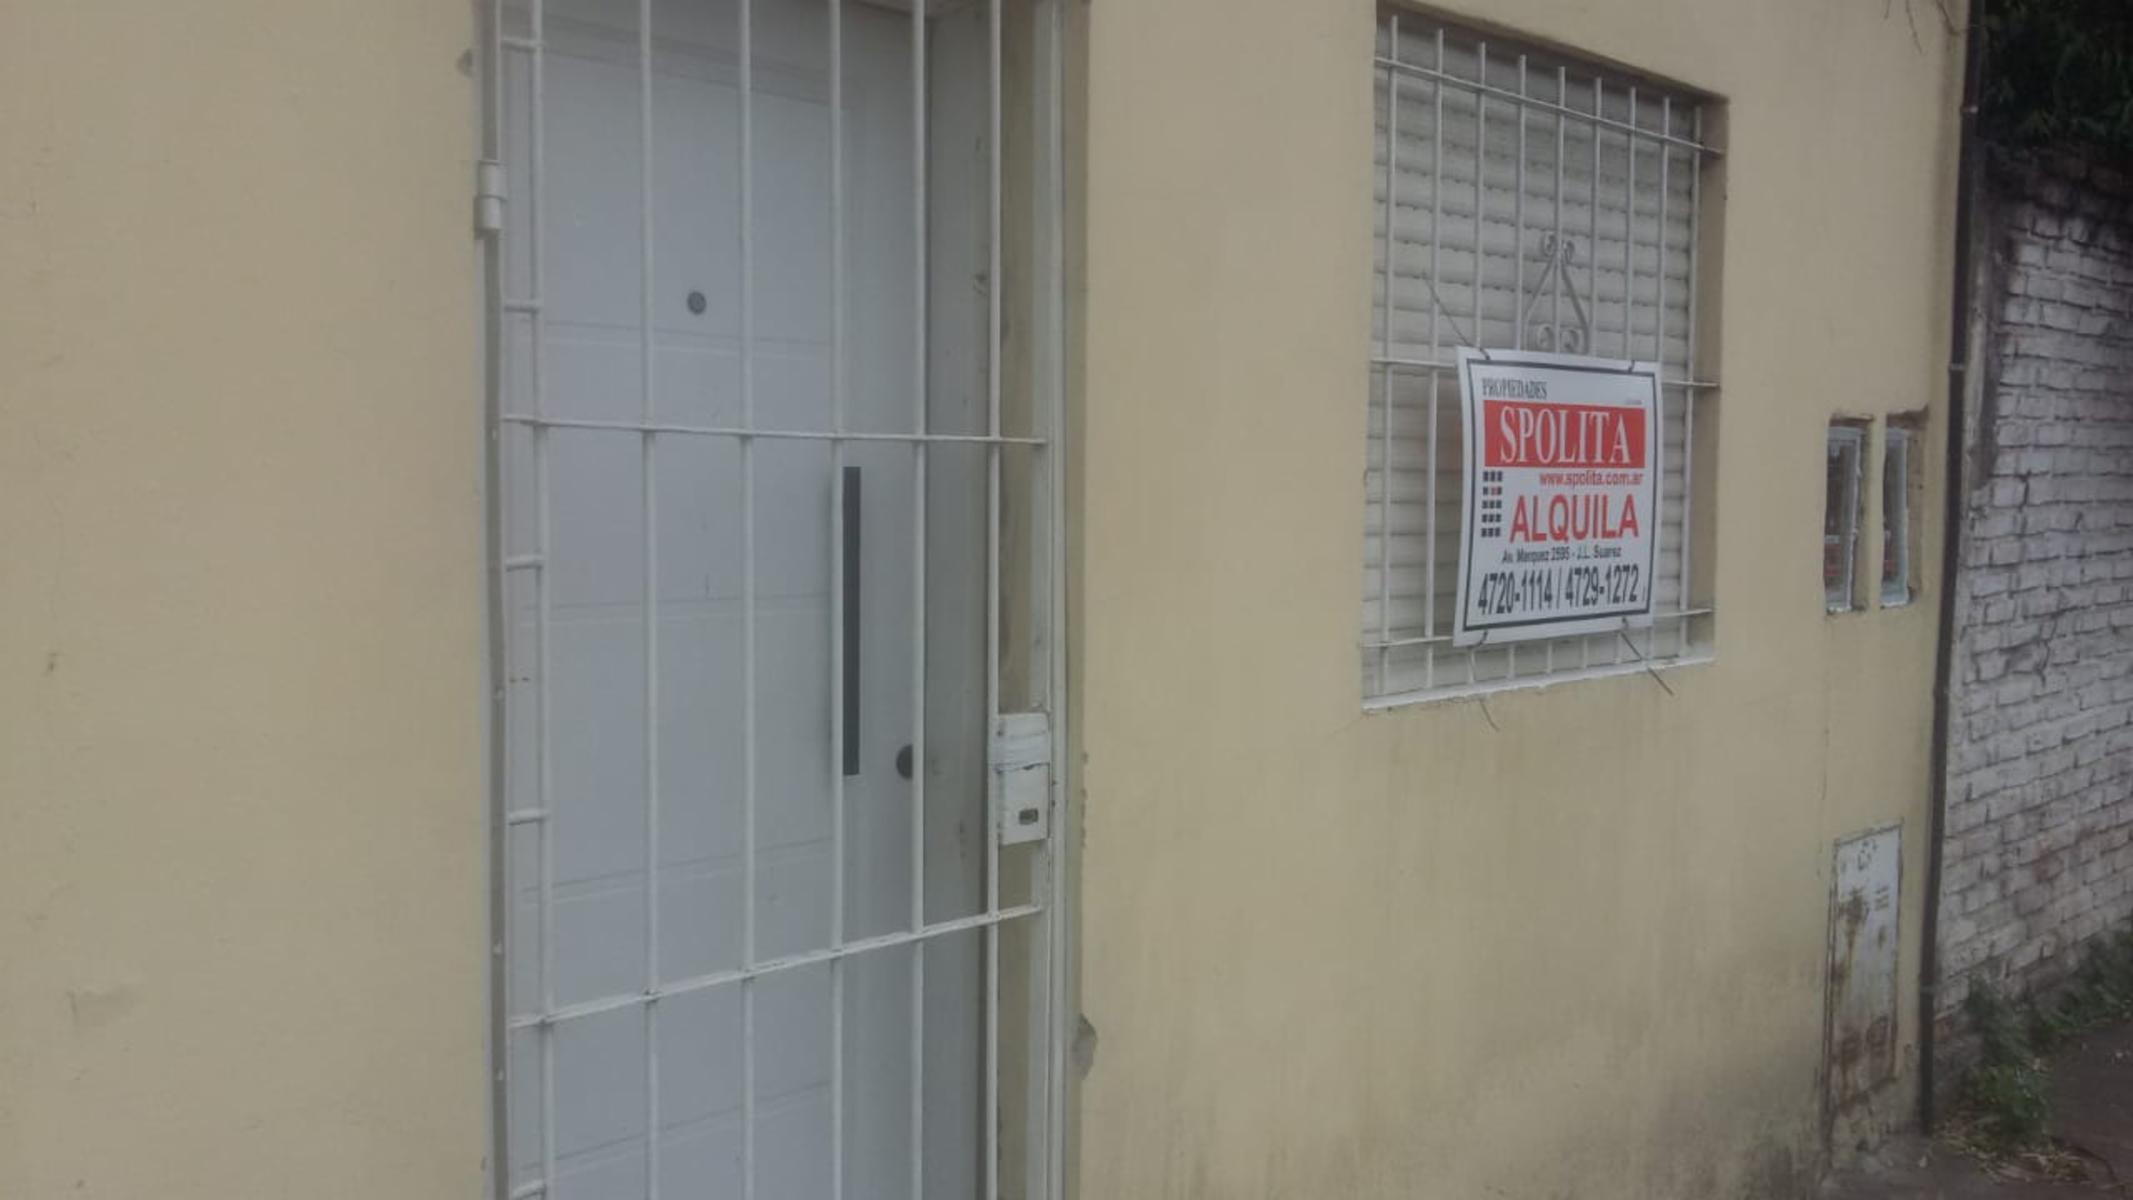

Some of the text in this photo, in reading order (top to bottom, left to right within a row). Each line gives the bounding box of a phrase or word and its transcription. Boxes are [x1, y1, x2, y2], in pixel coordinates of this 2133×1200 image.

[1500, 406, 1632, 464] SPOLITA
[1539, 470, 1644, 488] www.spolita.com.ar
[1509, 494, 1639, 543] ALQUILA
[1478, 568, 1553, 614] 4720-1114
[1565, 564, 1639, 608] 4729-1272
